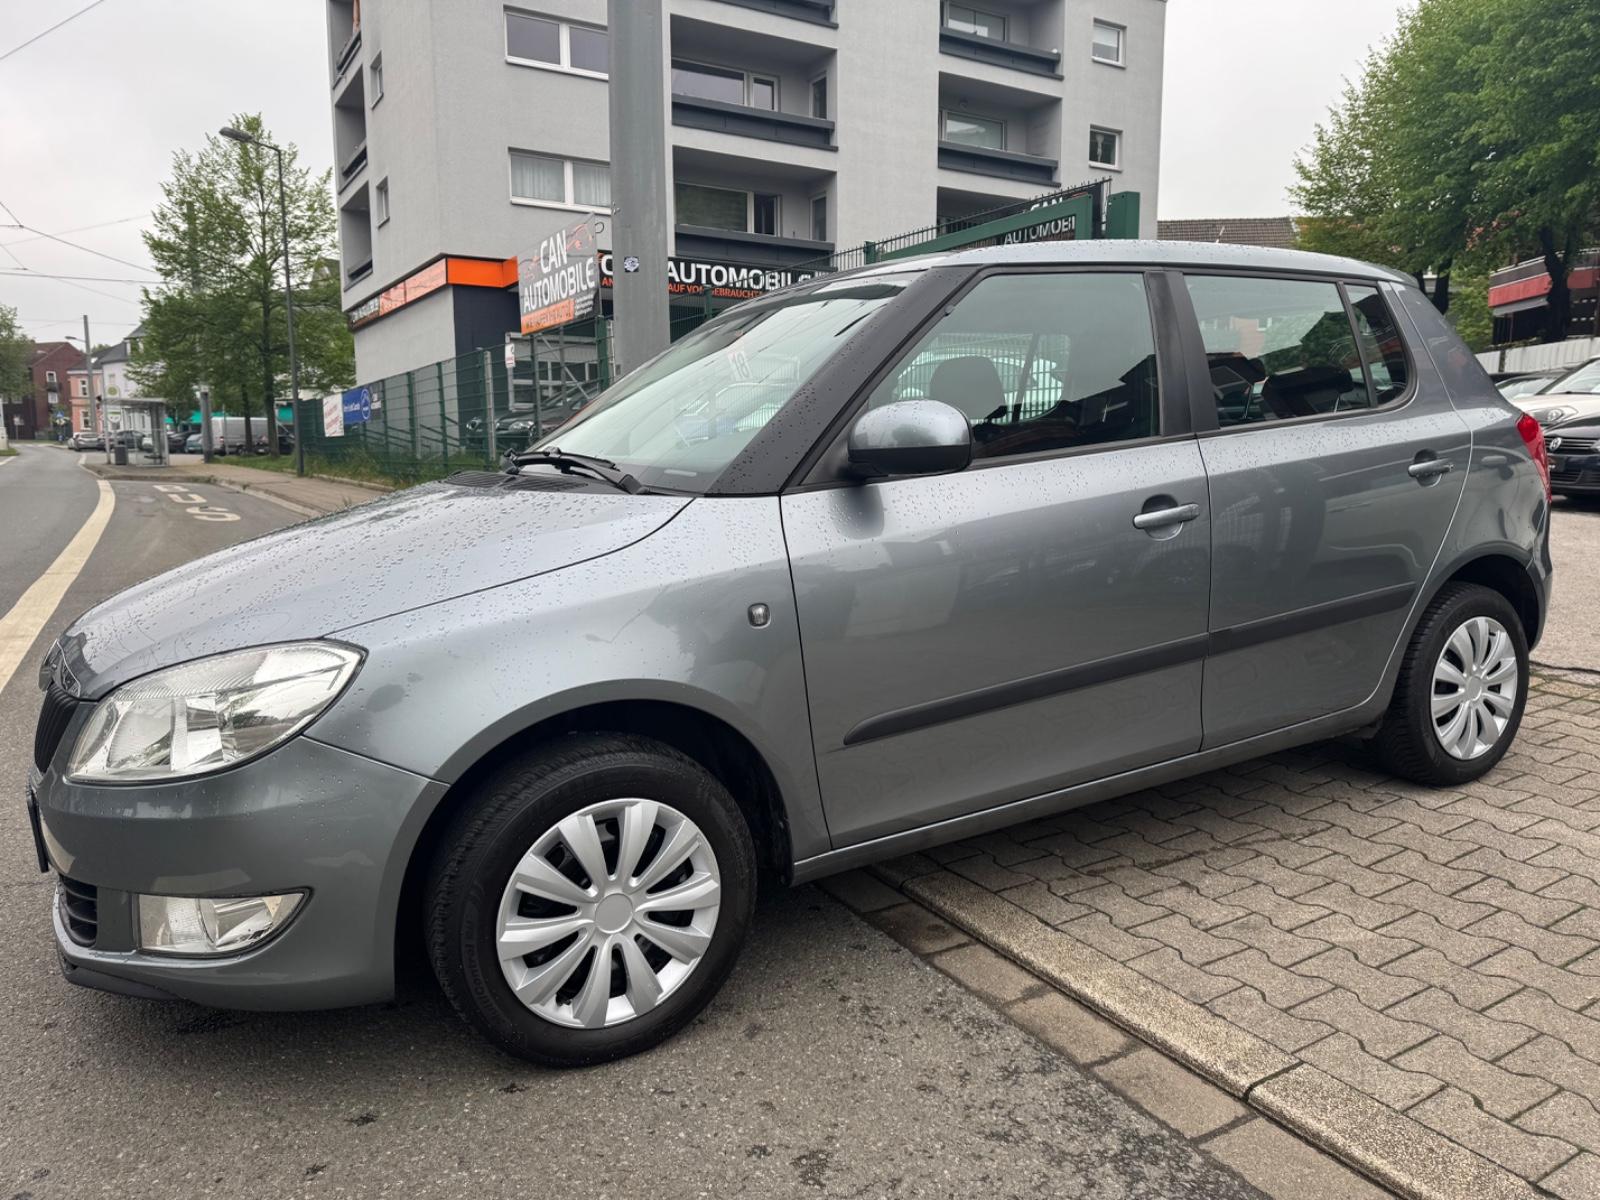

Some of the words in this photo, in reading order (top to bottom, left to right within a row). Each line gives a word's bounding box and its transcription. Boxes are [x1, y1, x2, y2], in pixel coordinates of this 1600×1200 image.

[540, 229, 567, 274] CAN
[523, 257, 595, 313] AUTOMOBILE
[668, 283, 686, 292] AUF
[152, 484, 241, 521] BUS
